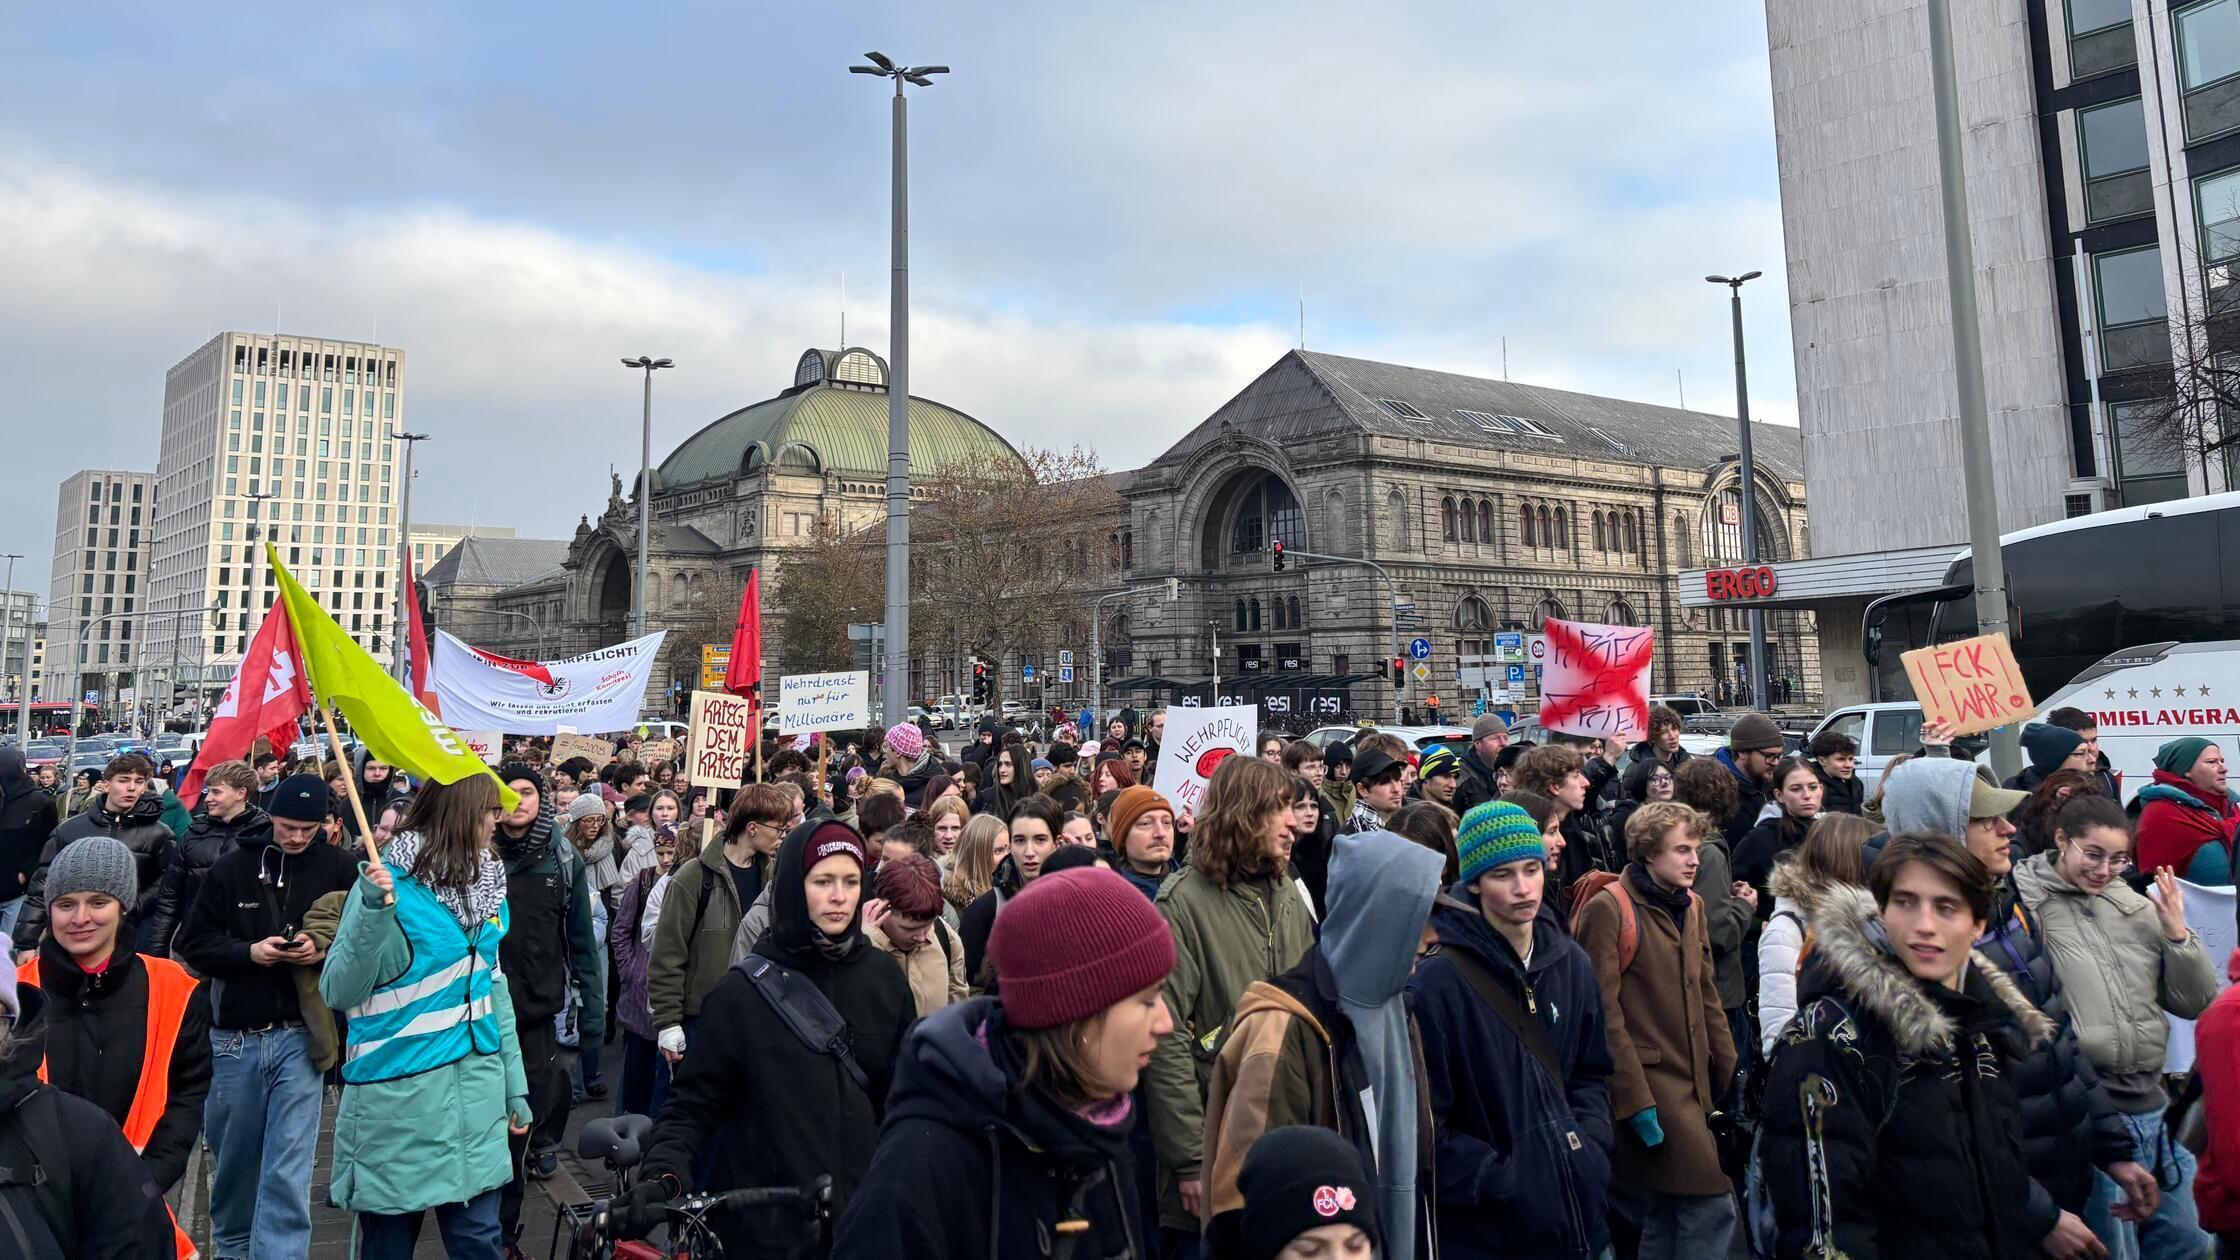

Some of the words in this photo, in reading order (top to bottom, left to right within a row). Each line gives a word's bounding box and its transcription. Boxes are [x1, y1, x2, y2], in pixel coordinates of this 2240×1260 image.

[1725, 507, 1737, 521] DB
[1705, 566, 1776, 599] ERGO
[1245, 660, 1259, 669] resi
[1284, 659, 1298, 668] resi
[1934, 644, 1994, 686] FCK
[784, 673, 857, 690] Wehrdienst
[1510, 667, 1520, 680] P
[490, 700, 505, 708] Wir
[577, 698, 613, 707] erfassen
[825, 690, 850, 705] für
[1949, 683, 2011, 723] WAR
[534, 707, 586, 715] rekrutieren!
[703, 699, 746, 729] KRIEG
[784, 711, 855, 729] Millionäre
[706, 726, 740, 754] DEM
[697, 750, 742, 780] KRIEG
[1317, 1198, 1338, 1209] FCN
